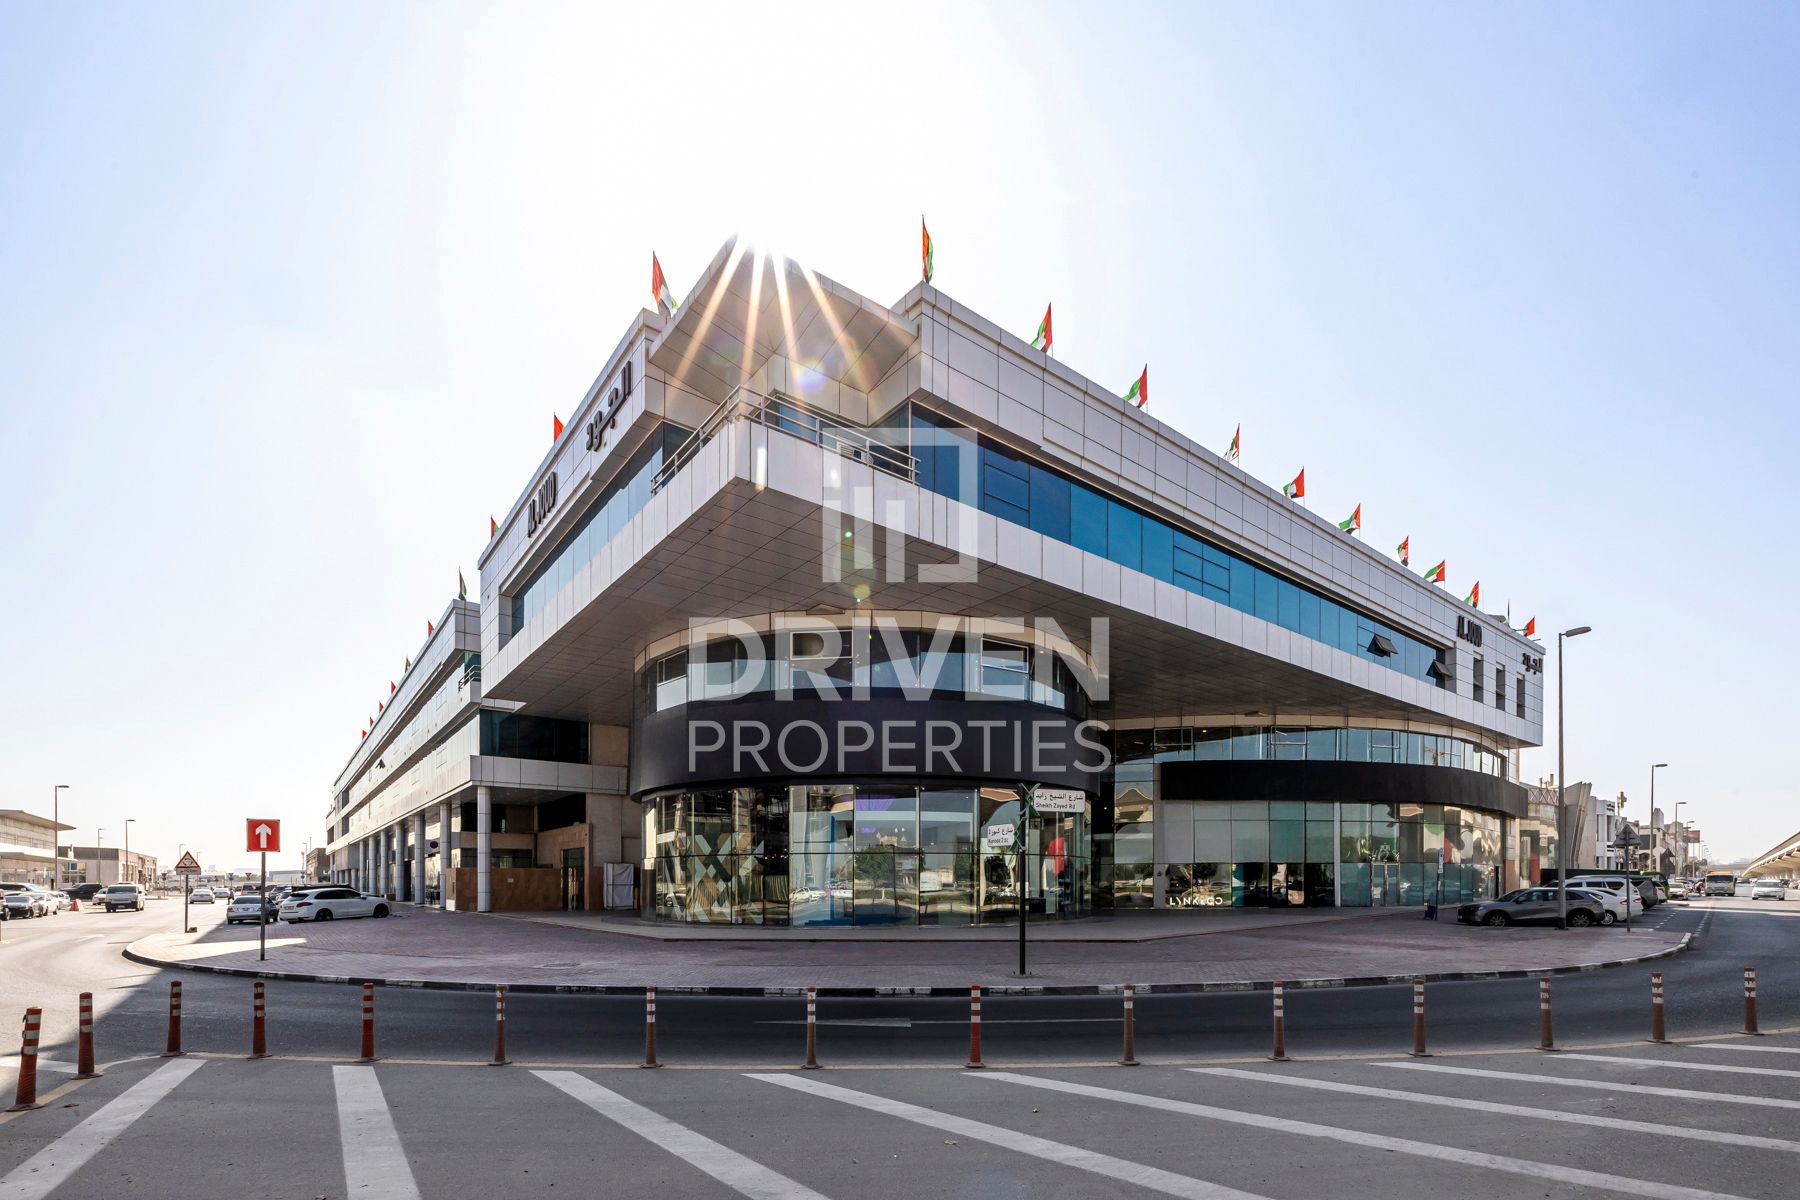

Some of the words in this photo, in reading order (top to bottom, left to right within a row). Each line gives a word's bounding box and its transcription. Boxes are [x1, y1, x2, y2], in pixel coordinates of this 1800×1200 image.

[1036, 791, 1047, 801] زايد
[1050, 792, 1067, 802] الشيخ
[1069, 793, 1084, 802] شارع
[1002, 826, 1013, 836] شارع
